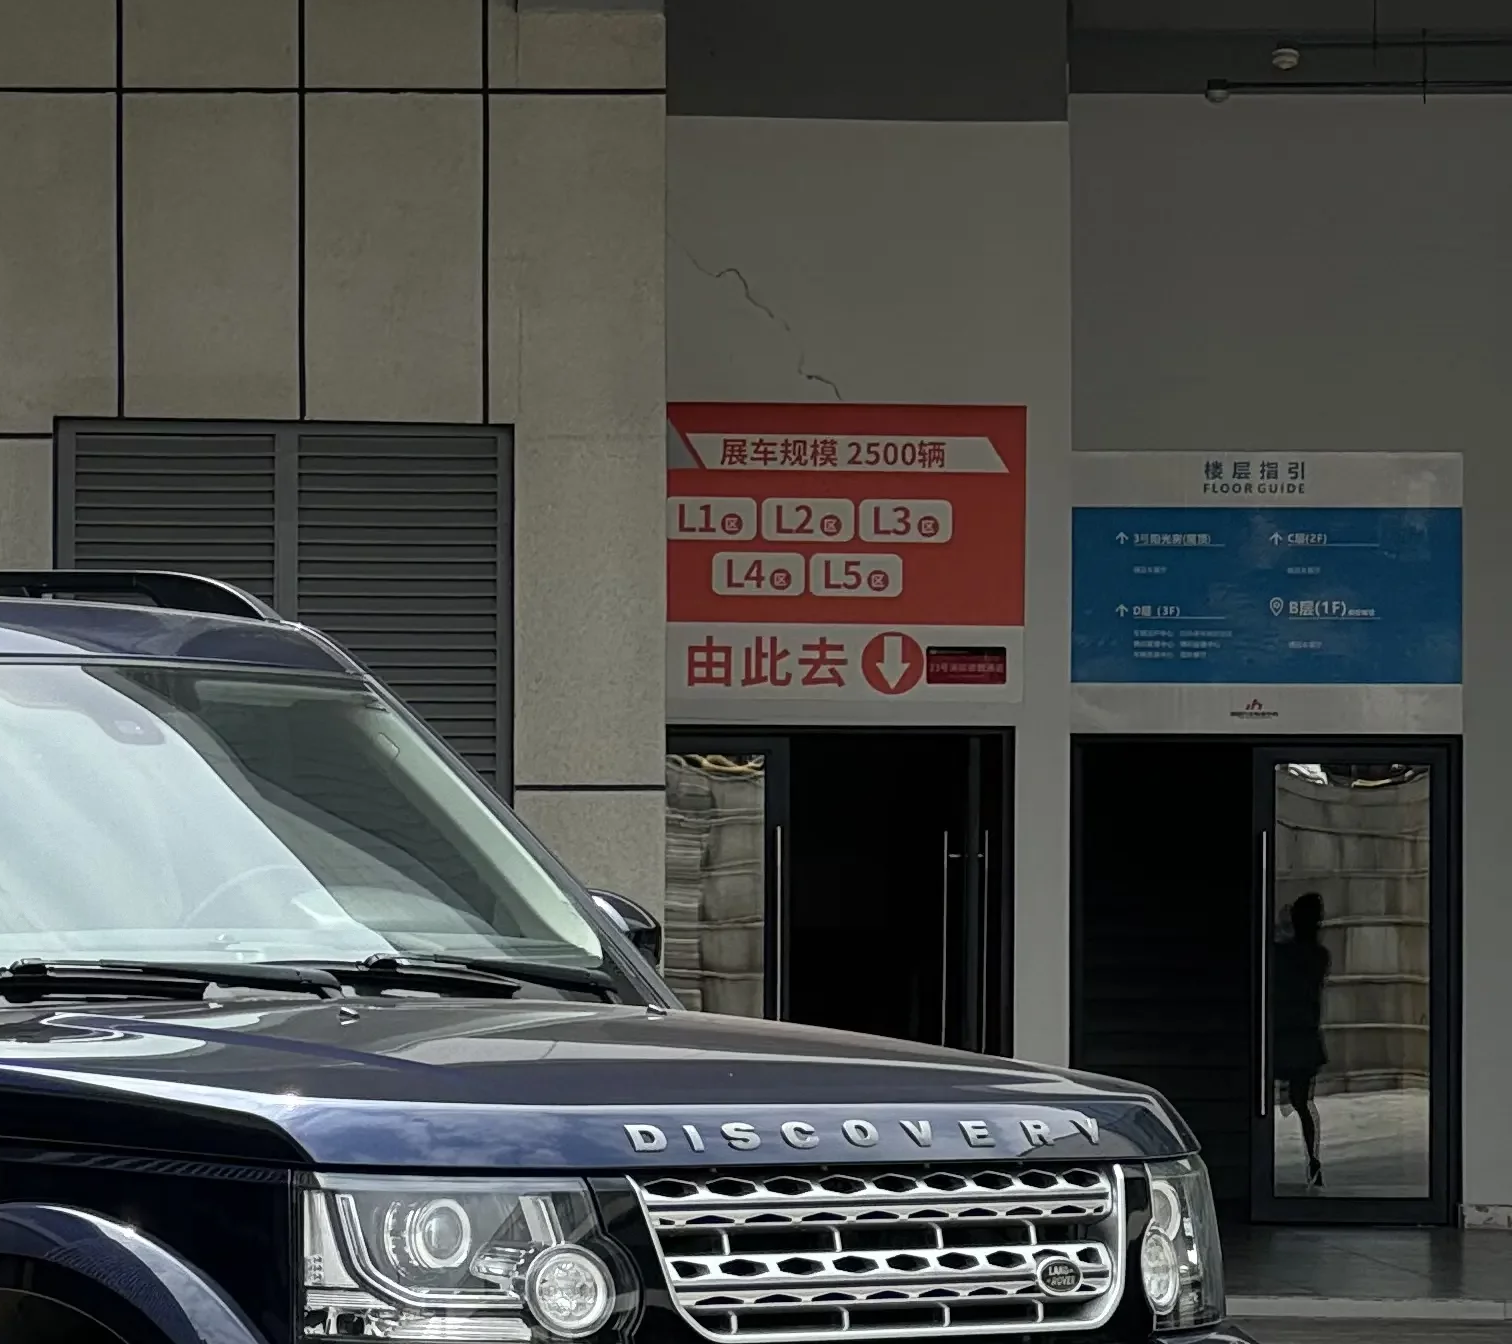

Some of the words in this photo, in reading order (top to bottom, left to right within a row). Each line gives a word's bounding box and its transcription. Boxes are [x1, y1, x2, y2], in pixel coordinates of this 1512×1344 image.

[720, 438, 838, 468] 展车规模
[847, 439, 946, 469] 2500辆
[1204, 460, 1305, 480] 楼层指引
[1203, 483, 1253, 494] FLOOR
[1257, 483, 1305, 494] GUIDE
[1289, 600, 1347, 616] B层(1F)
[688, 635, 848, 687] 由此去
[623, 1117, 1101, 1154] DISCOVERY
